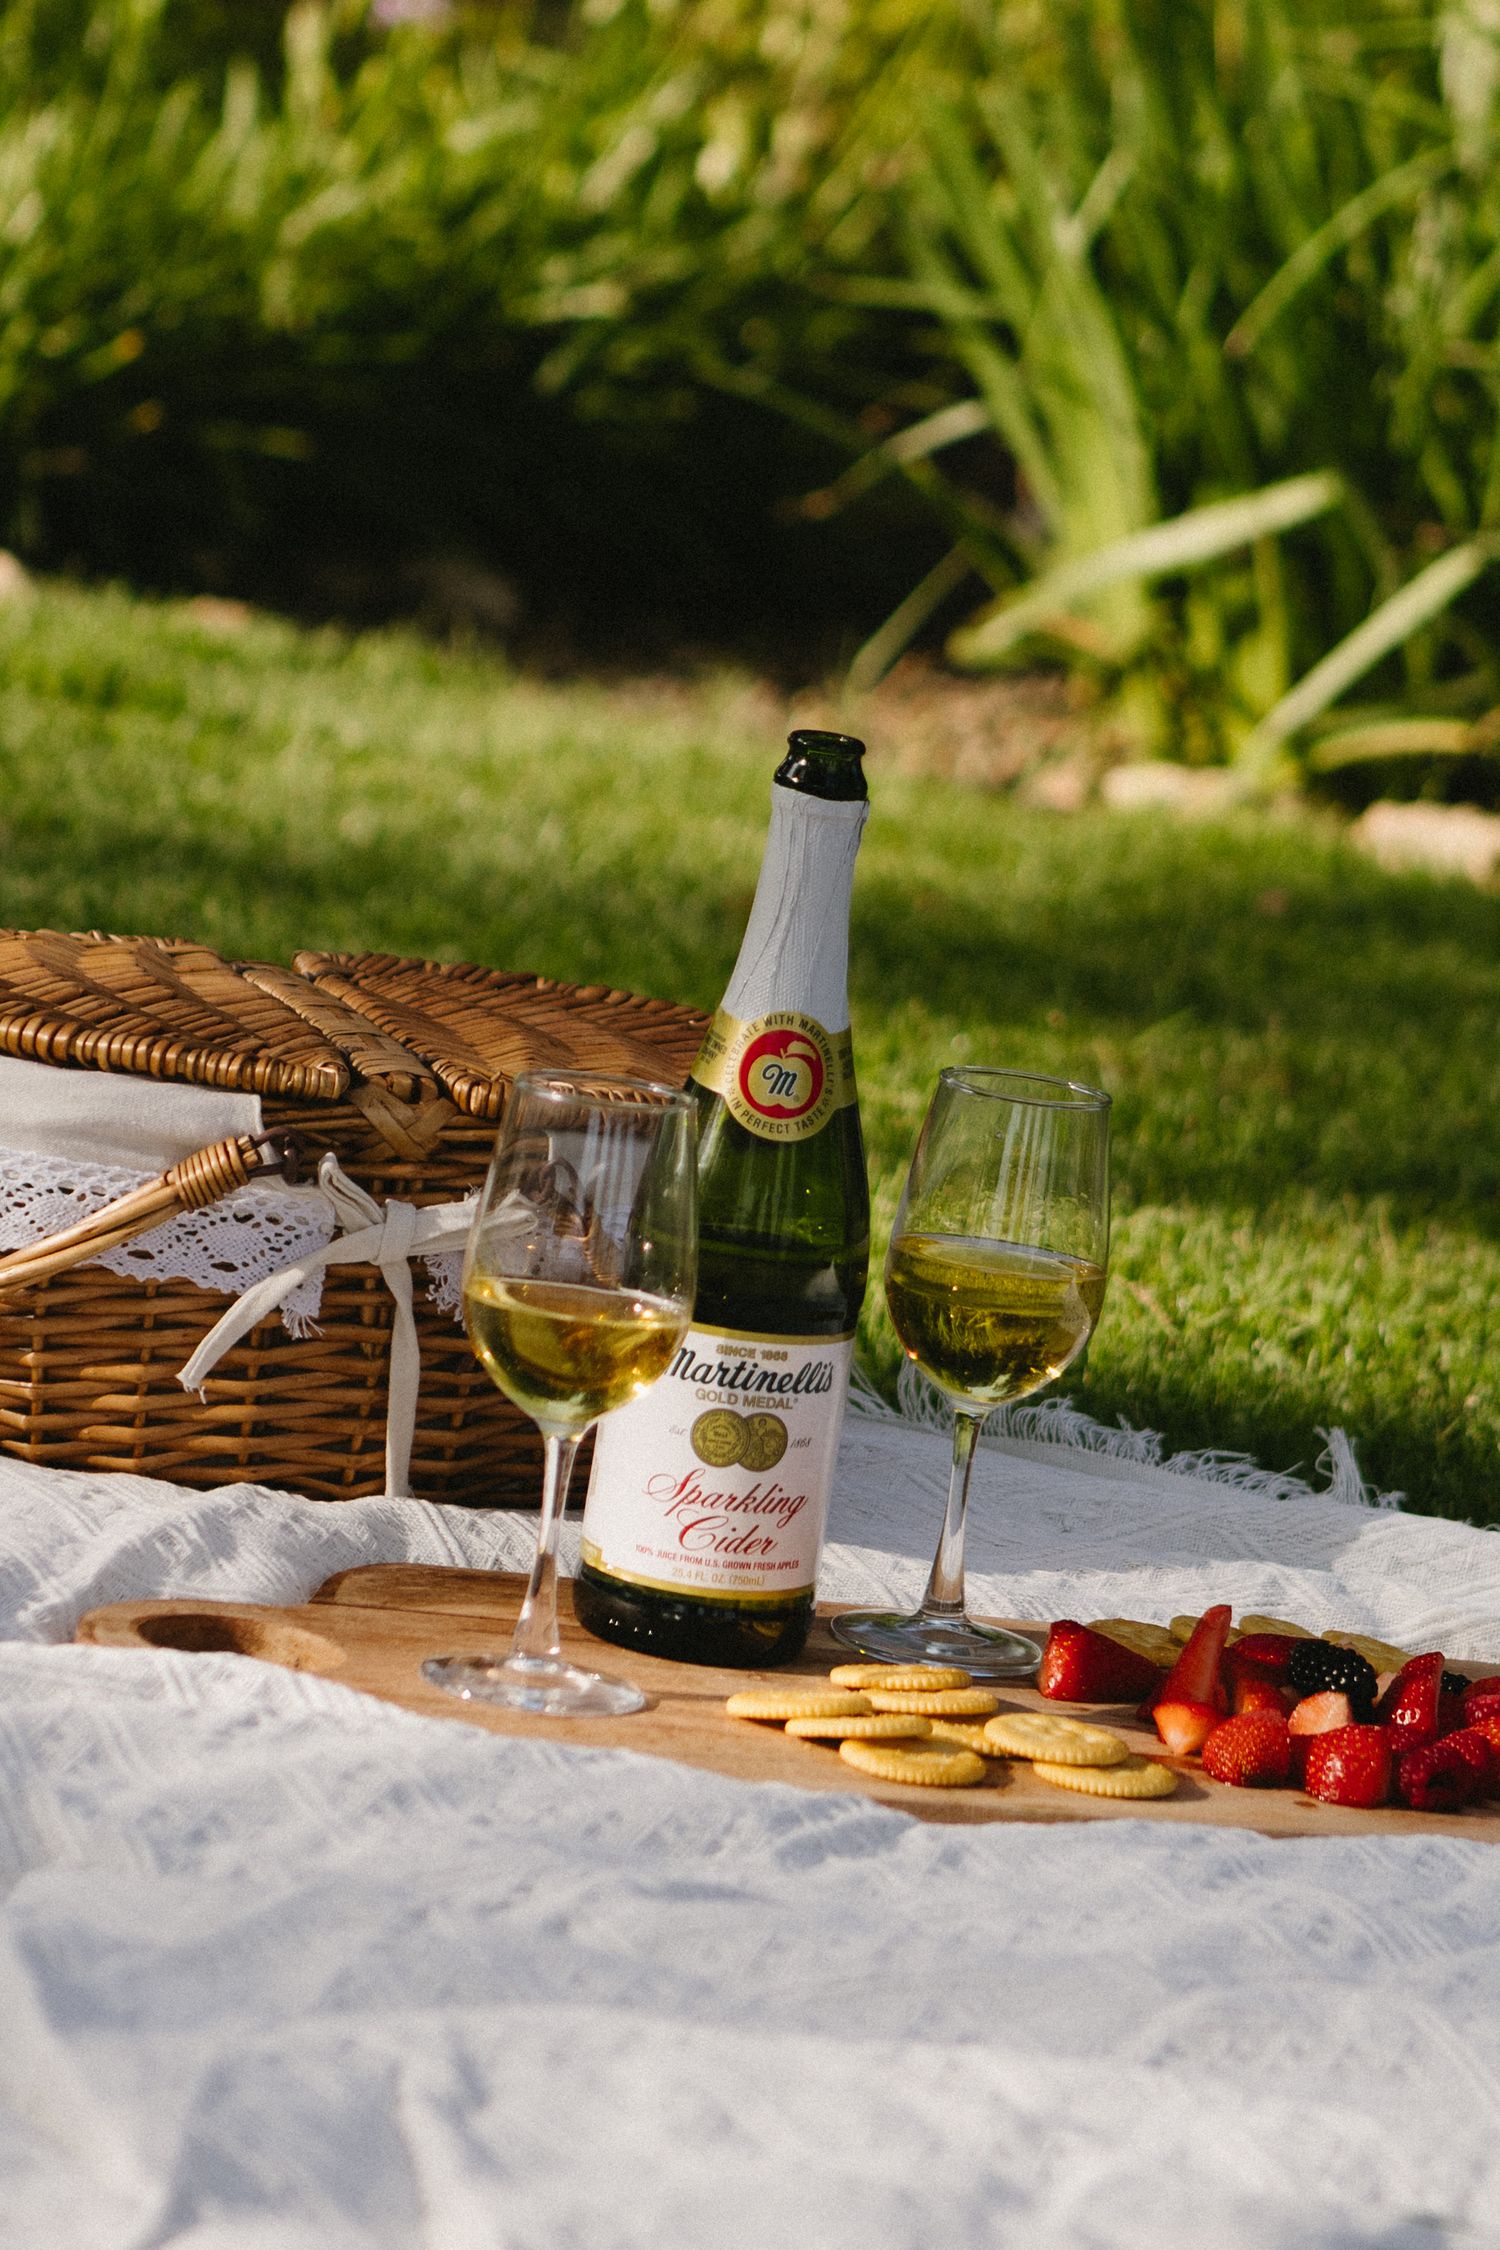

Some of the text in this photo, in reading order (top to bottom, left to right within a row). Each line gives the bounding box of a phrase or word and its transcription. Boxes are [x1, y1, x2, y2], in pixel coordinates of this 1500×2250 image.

[763, 1013, 795, 1027] WITH
[730, 1096, 825, 1135] IN PERFECT TASTE
[715, 1343, 789, 1362] SINCE 1868
[695, 1388, 738, 1406] GOLD
[645, 1468, 808, 1529] Sparkling
[677, 1508, 778, 1556] Cider
[656, 1549, 677, 1562] JUICE
[679, 1554, 703, 1567] FROM
[704, 1558, 720, 1569] U.S.
[722, 1559, 752, 1571] GROWN
[753, 1559, 777, 1571] FRESH
[776, 1558, 800, 1571] APPLES
